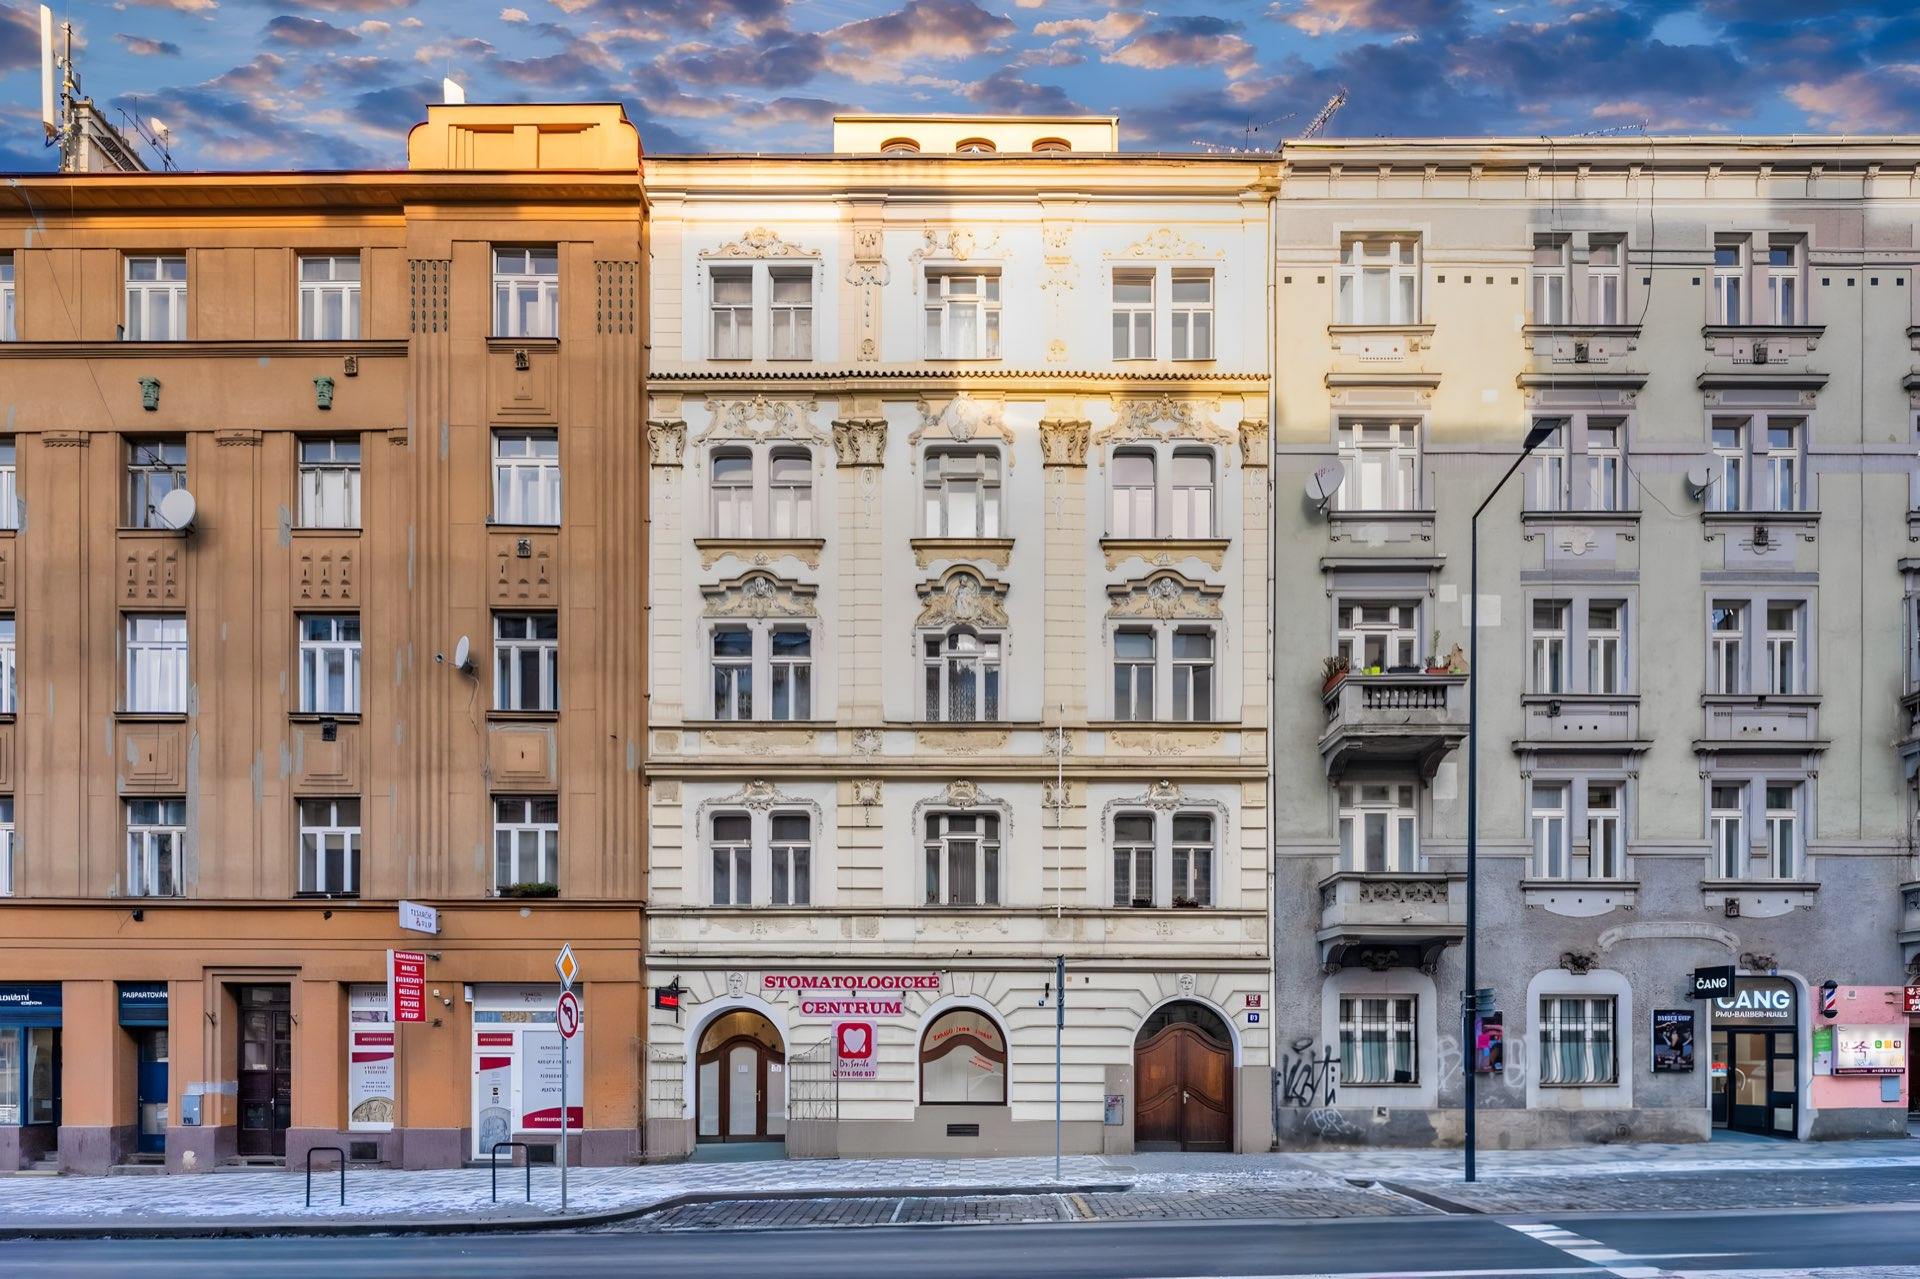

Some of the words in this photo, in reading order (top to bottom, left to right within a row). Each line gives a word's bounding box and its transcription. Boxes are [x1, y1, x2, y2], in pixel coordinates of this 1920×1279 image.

[764, 971, 940, 989] STOMATOLOGICKÉ
[1696, 977, 1728, 990] ČANG
[801, 1001, 902, 1014] CENTRUM
